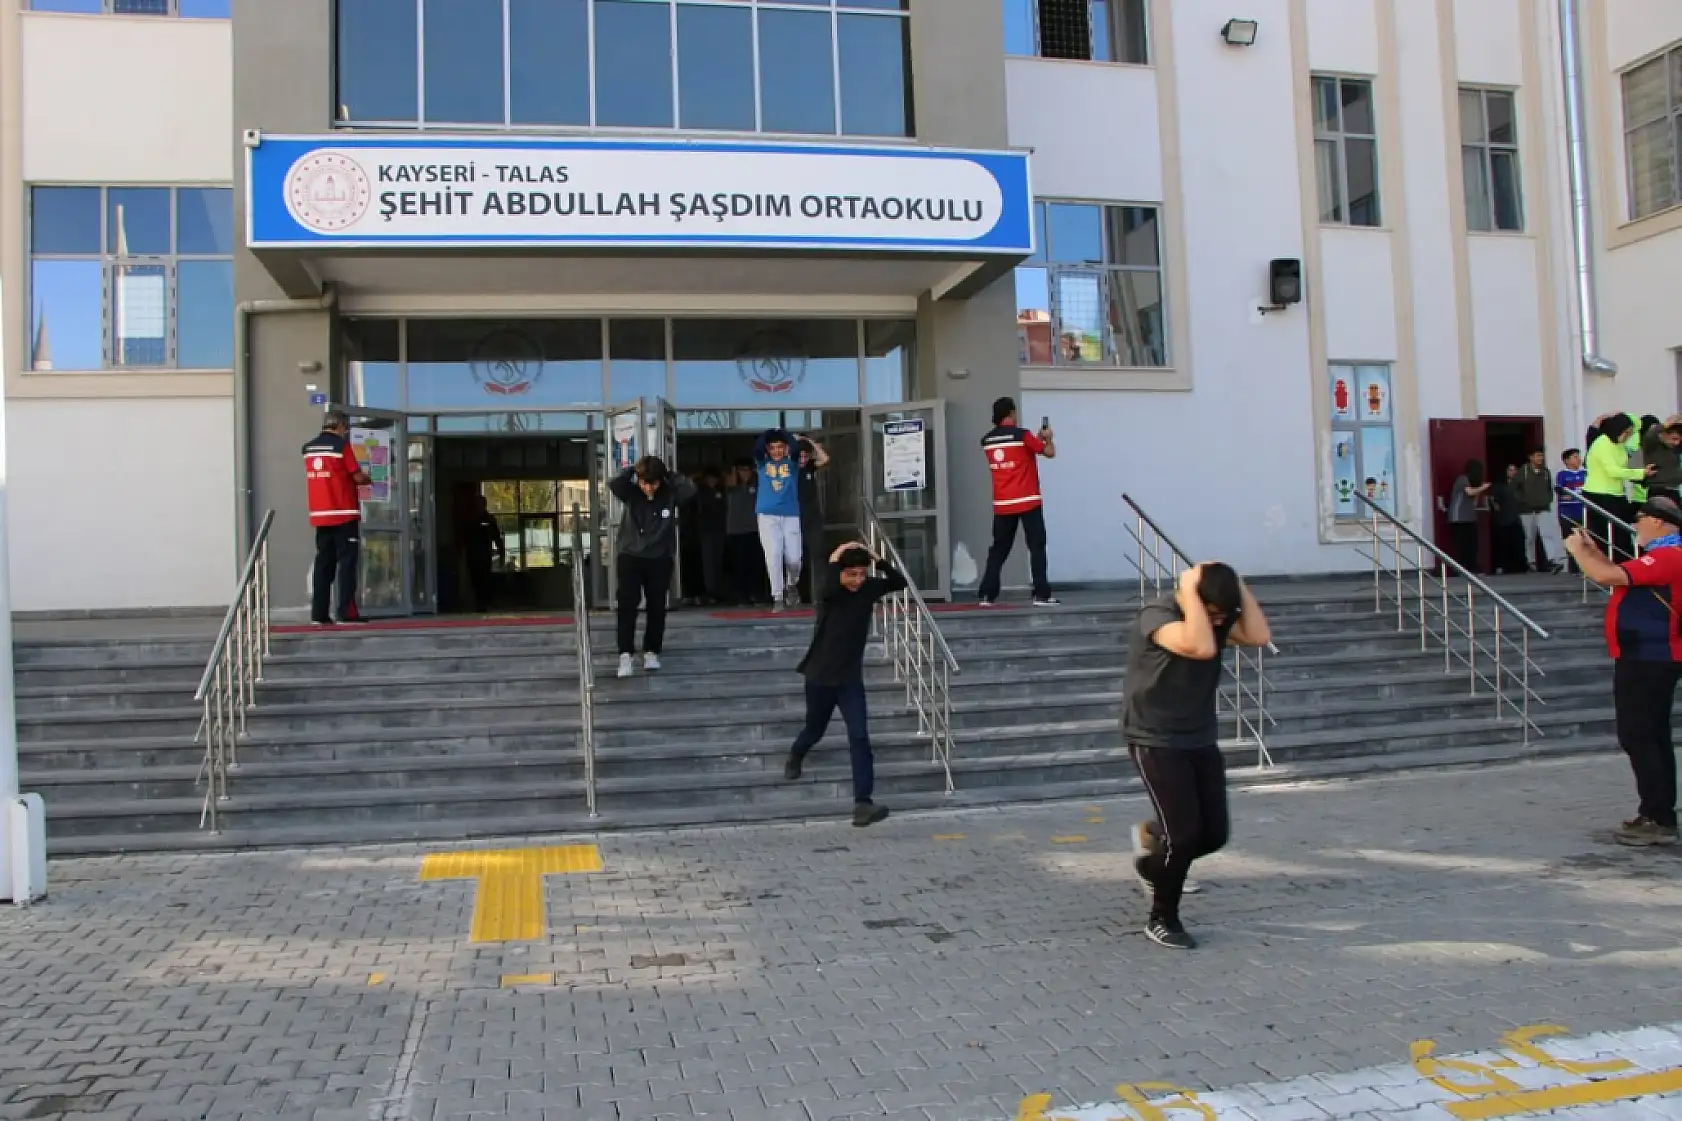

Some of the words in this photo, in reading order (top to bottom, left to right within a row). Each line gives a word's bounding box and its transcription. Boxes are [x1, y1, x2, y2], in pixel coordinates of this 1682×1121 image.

[378, 161, 475, 183] KAYSERİ
[495, 164, 569, 184] TALAS
[379, 185, 474, 222] ŞEHİT
[482, 192, 660, 217] ABDULLAH
[669, 192, 792, 223] ŞAŞDIM
[799, 195, 984, 222] ORTAOKULU
